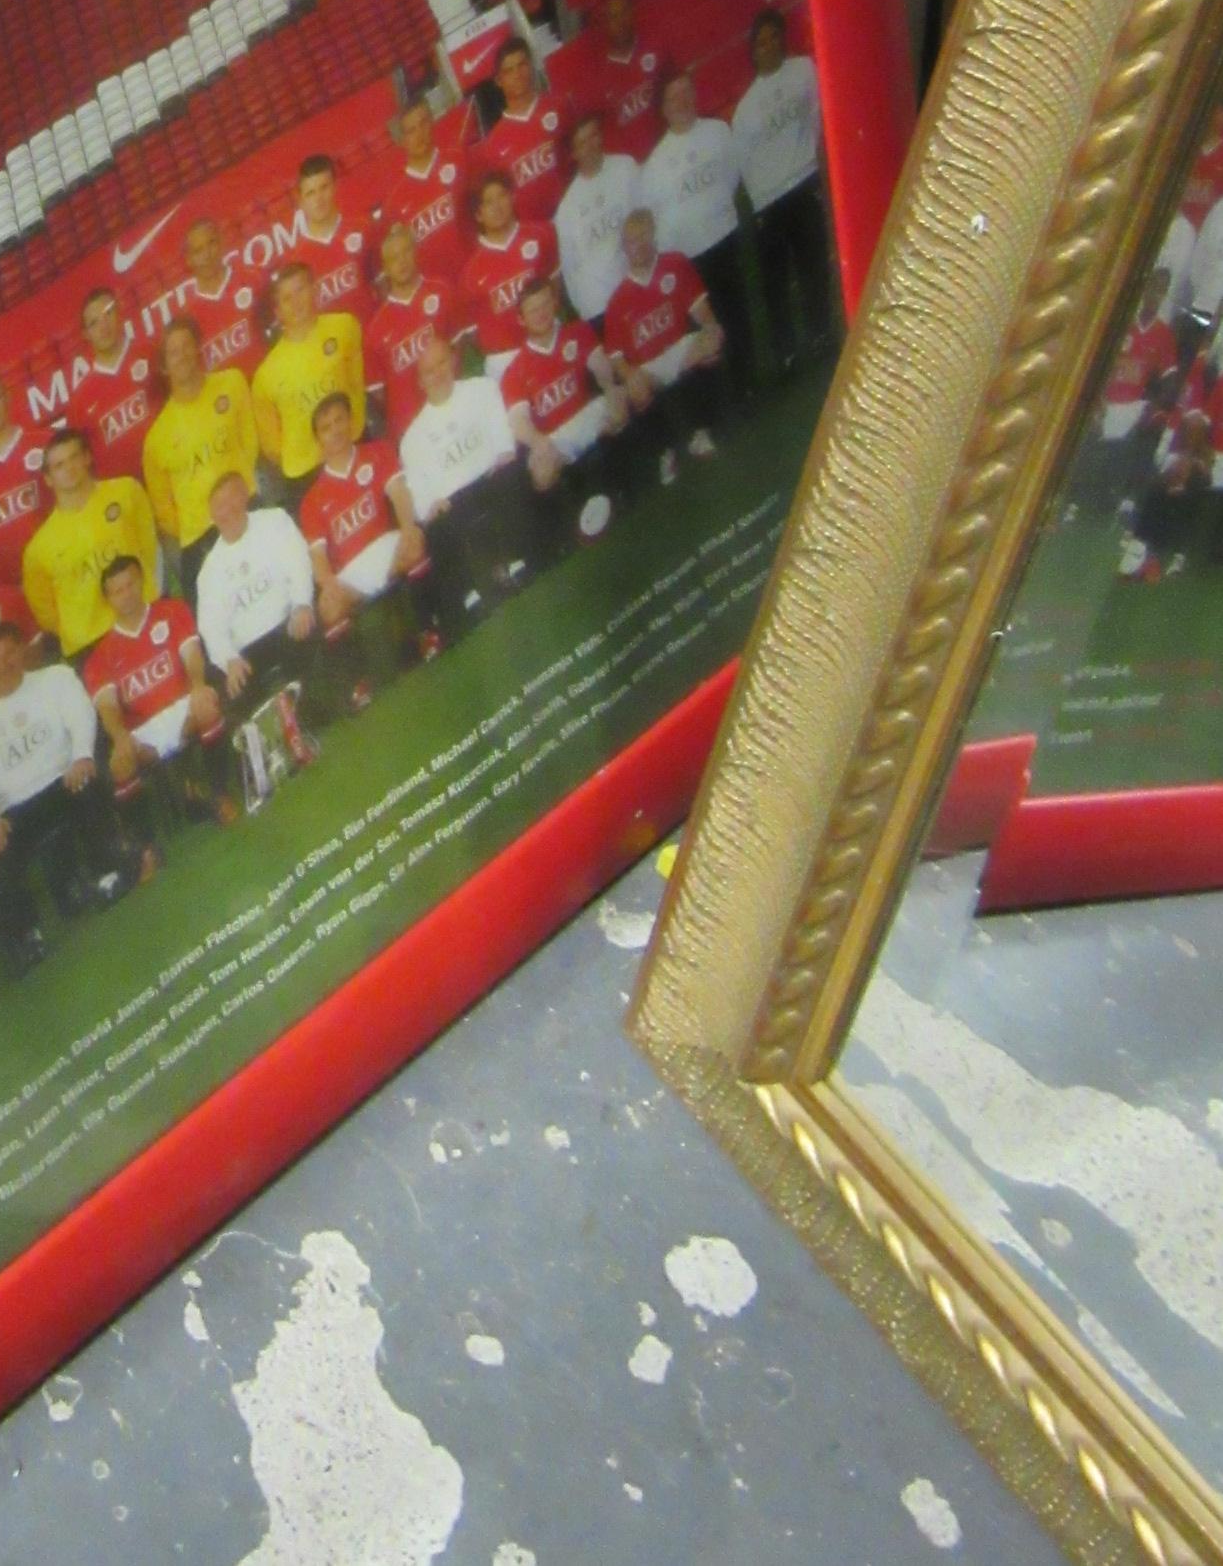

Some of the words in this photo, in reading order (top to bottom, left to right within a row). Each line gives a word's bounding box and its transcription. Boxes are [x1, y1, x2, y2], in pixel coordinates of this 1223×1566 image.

[517, 148, 556, 183] AIG
[413, 200, 453, 238] AIG
[317, 265, 357, 305] AIG
[206, 323, 249, 368] AIG
[538, 377, 575, 415] AIG
[104, 394, 147, 440] AIG
[335, 500, 375, 541] AIG
[126, 658, 172, 696] AIG
[158, 944, 205, 987] Darren
[431, 729, 480, 772] Michael
[221, 979, 266, 1018] Carlos
[315, 908, 349, 940] Ryan
[492, 770, 520, 797] Gary
[209, 958, 239, 985] Tom
[328, 867, 353, 890] van
[353, 848, 375, 873] der
